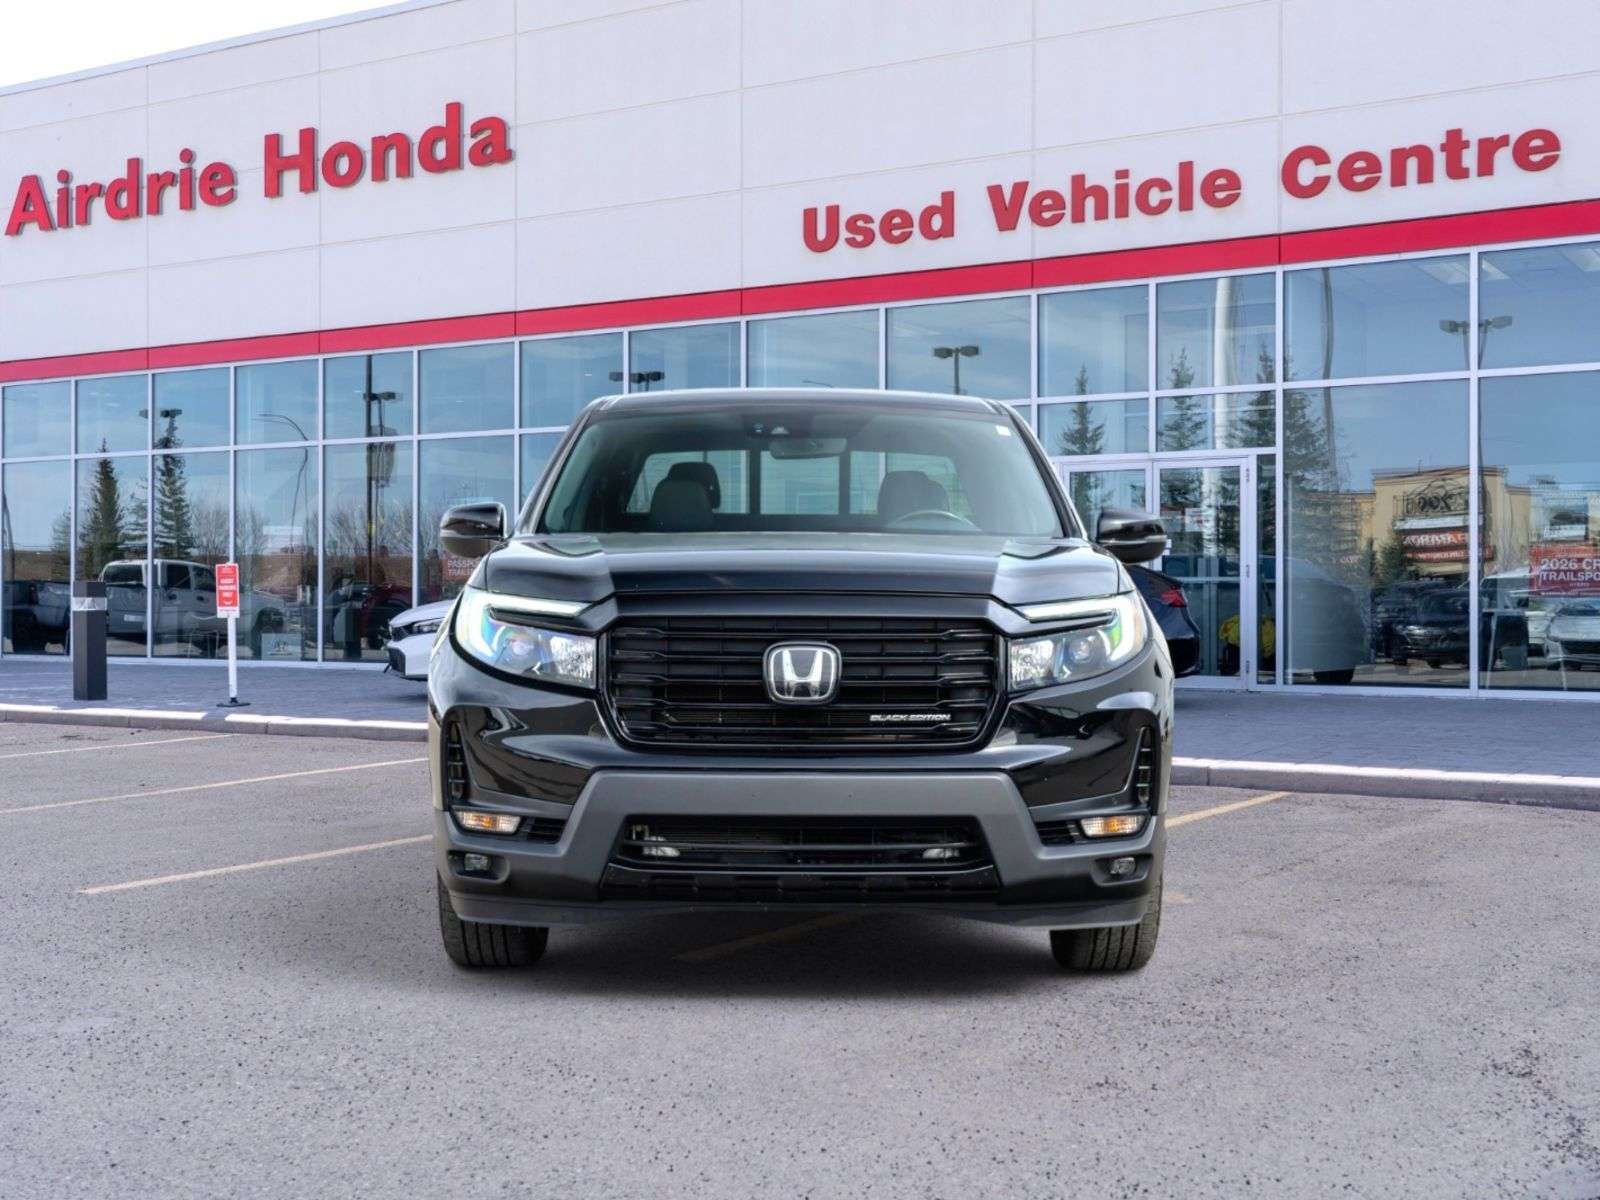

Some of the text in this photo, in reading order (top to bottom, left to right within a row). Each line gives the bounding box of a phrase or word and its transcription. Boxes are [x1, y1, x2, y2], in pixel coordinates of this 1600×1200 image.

[5, 102, 513, 236] Airdrie Honda
[803, 128, 1560, 253] Used Vehicle Centre
[1540, 558, 1578, 570] 2026
